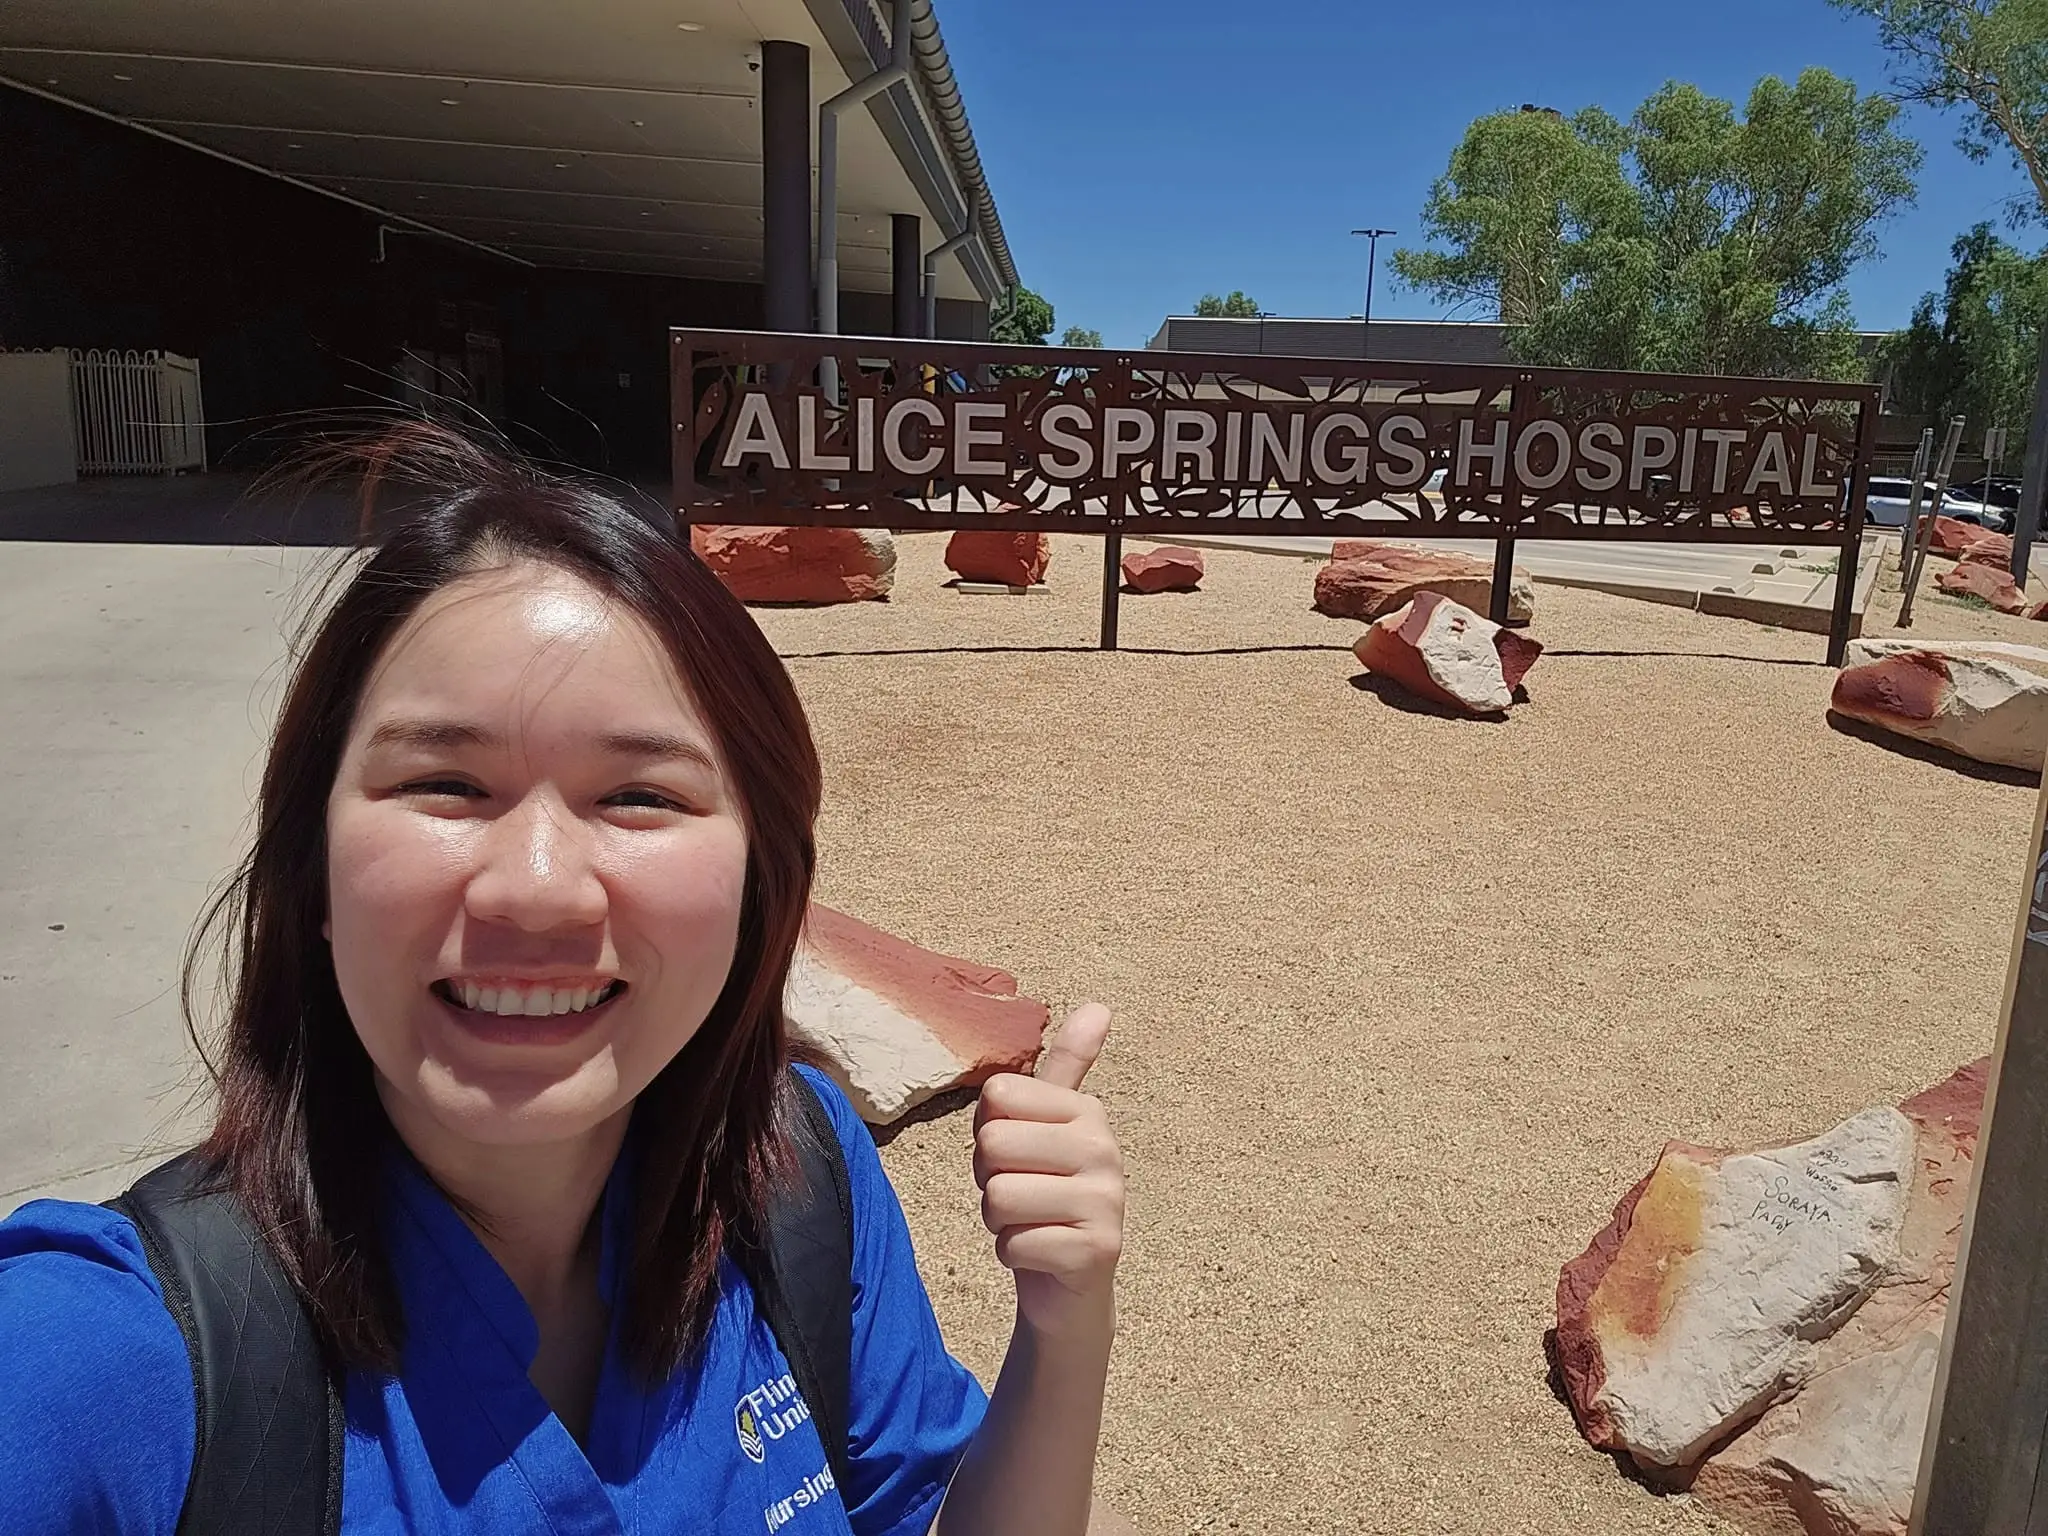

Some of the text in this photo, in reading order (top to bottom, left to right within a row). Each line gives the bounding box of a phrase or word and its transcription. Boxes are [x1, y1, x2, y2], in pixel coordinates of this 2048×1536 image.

[721, 392, 1839, 498] ALICE SPRINGS HOSPITAL
[747, 1373, 798, 1419] Flin
